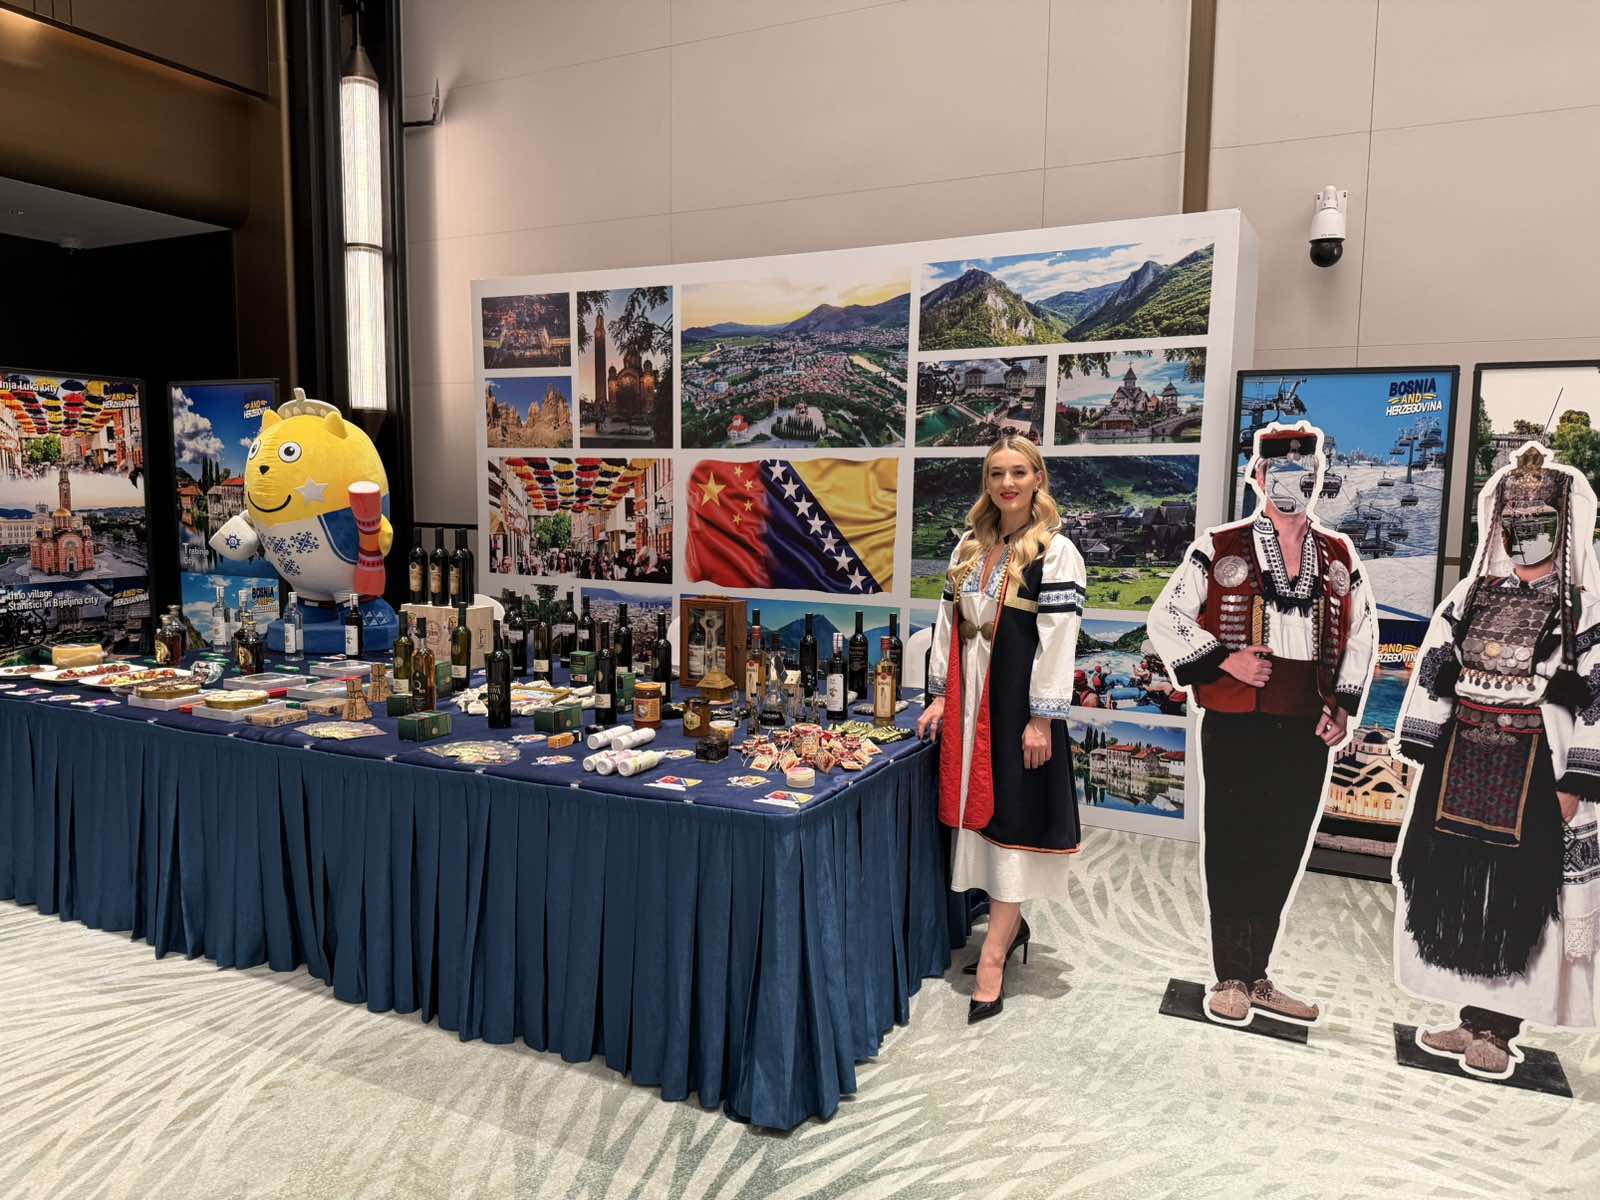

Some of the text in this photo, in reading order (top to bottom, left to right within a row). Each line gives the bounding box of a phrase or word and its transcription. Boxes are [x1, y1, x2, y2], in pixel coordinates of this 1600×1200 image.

[19, 380, 39, 391] Luka
[1388, 377, 1437, 397] BOSNIA
[1401, 393, 1422, 405] AND
[1385, 400, 1443, 417] HERZEGOVINA
[27, 589, 53, 600] village
[84, 595, 99, 606] city
[1381, 643, 1403, 654] AND
